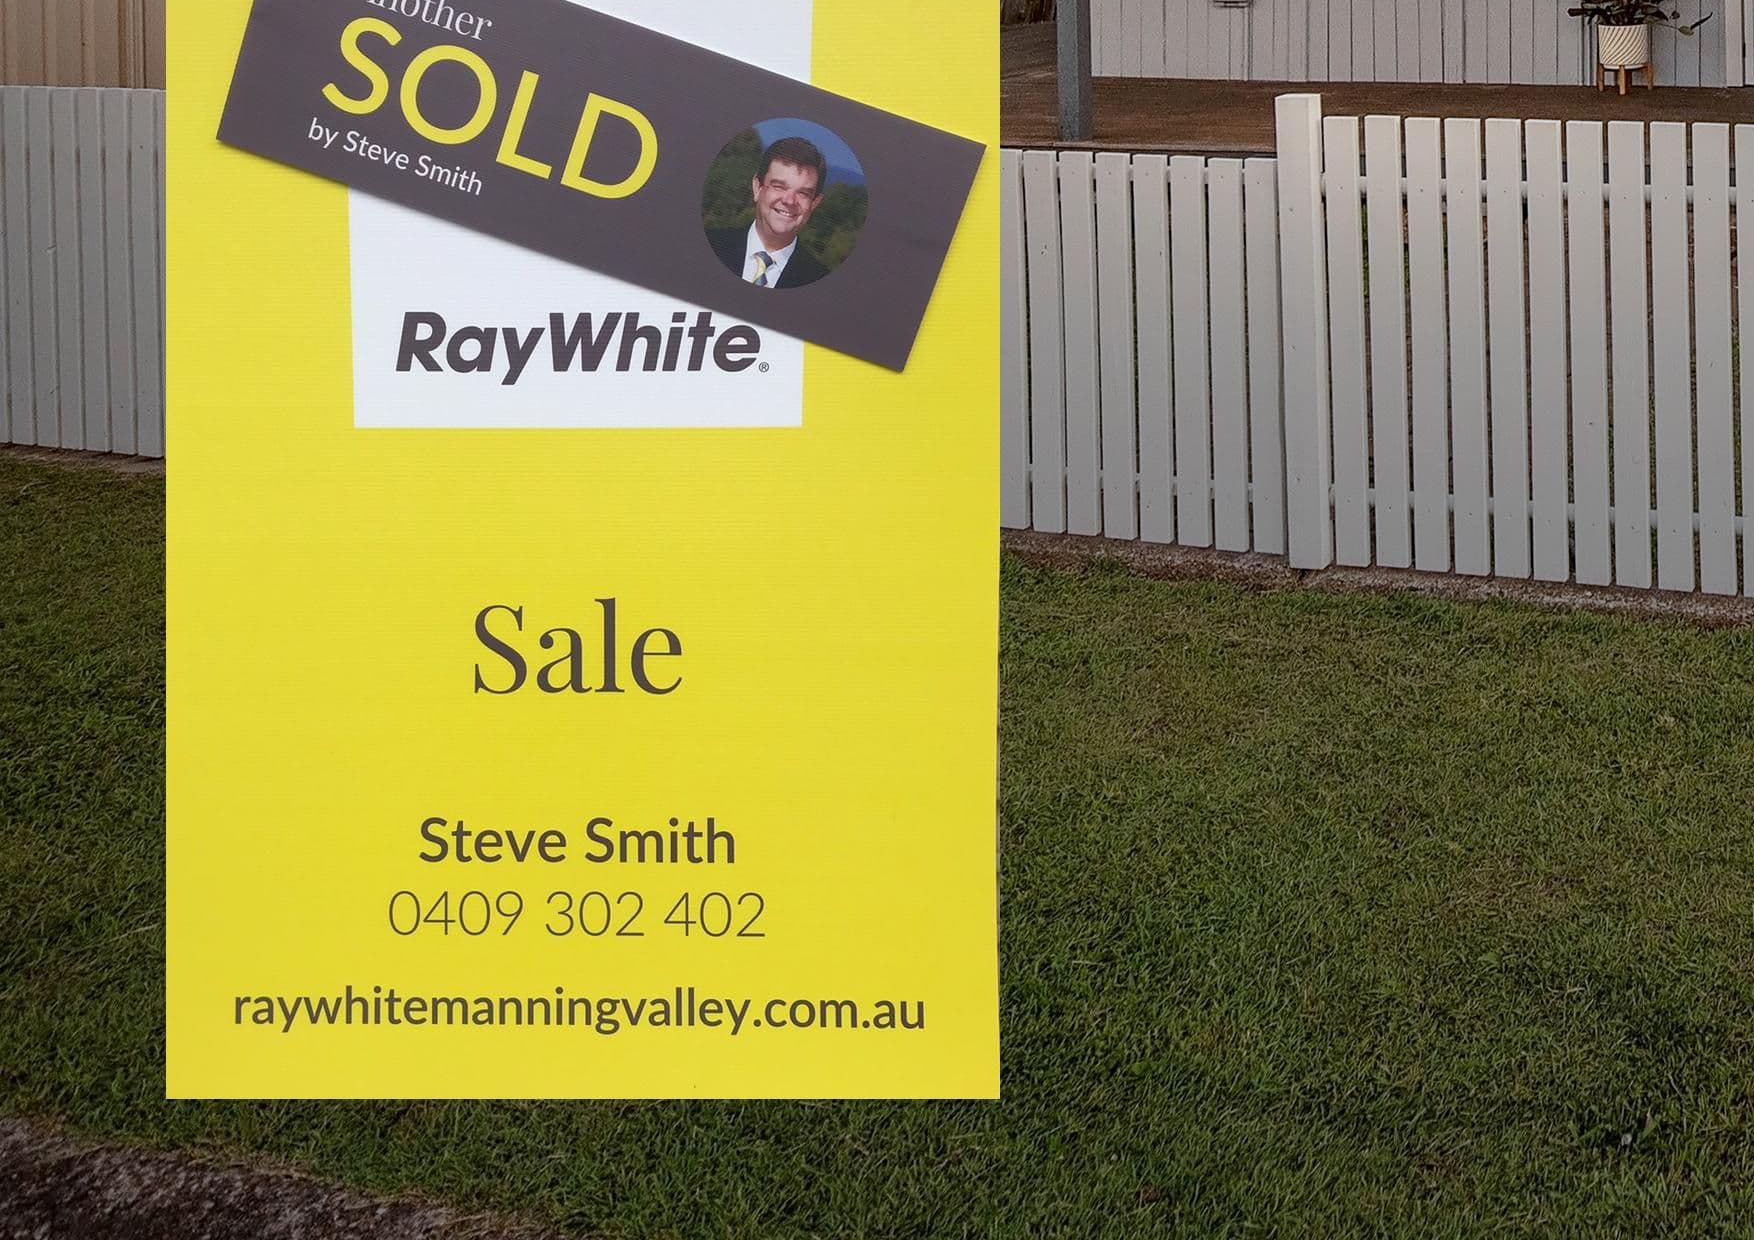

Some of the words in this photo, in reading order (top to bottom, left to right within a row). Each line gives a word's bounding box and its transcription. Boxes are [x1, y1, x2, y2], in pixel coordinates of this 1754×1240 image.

[322, 17, 659, 200] SOLD
[307, 116, 340, 149] by
[342, 130, 411, 170] Steve
[414, 154, 483, 196] Smith
[474, 597, 684, 696] Sale
[418, 816, 567, 864] Steve
[584, 817, 735, 864] Smith
[388, 890, 524, 937] 0409
[545, 890, 645, 937] 302
[663, 891, 767, 938] 402
[234, 984, 926, 1036] raywhitemanningvalley.com.au
